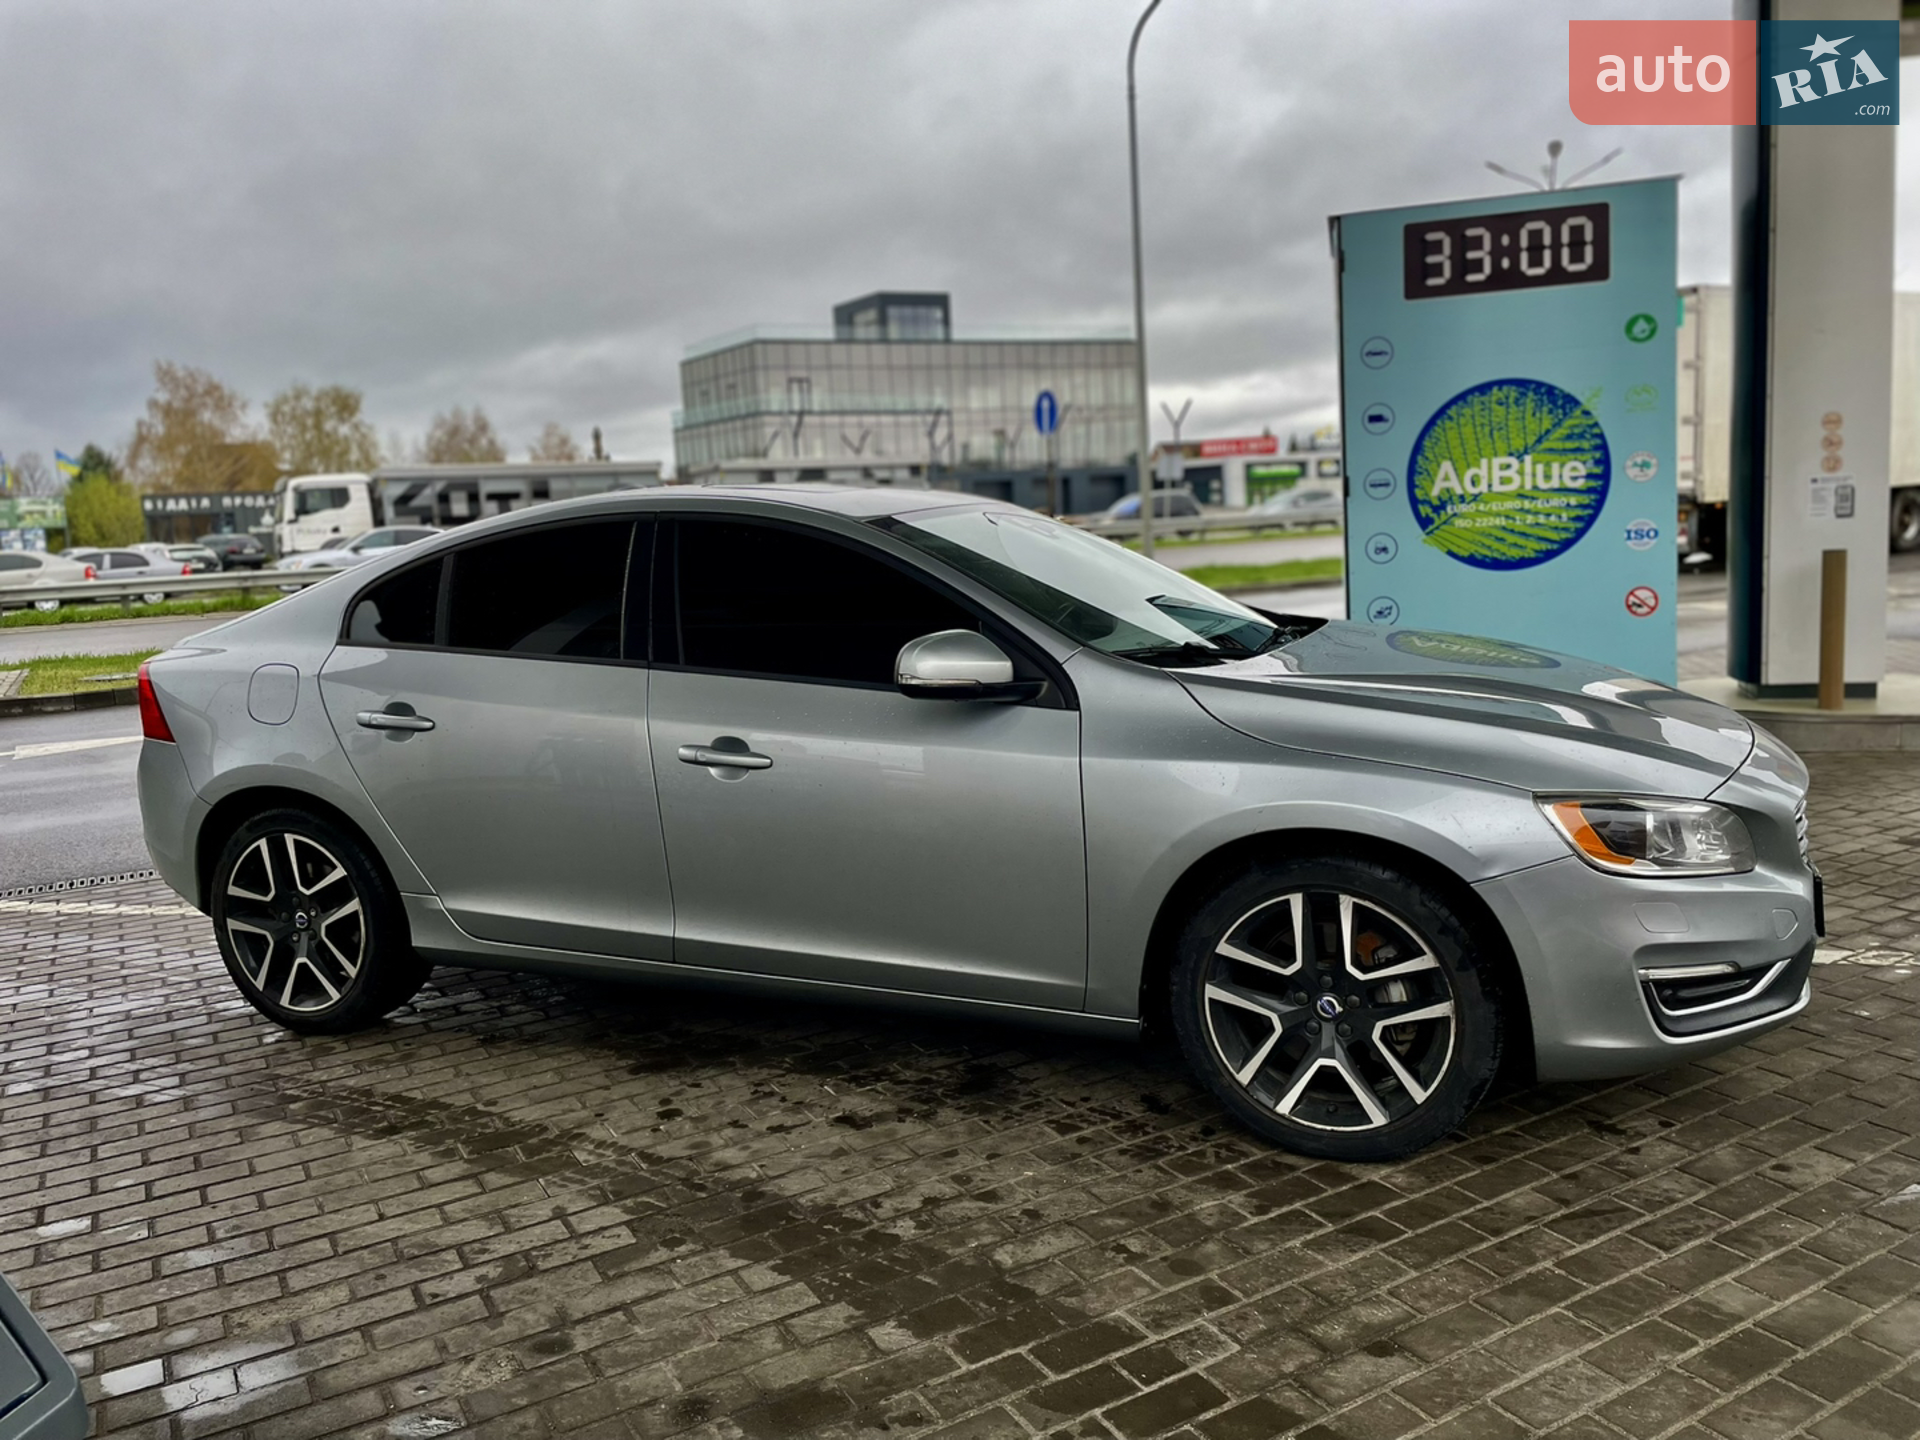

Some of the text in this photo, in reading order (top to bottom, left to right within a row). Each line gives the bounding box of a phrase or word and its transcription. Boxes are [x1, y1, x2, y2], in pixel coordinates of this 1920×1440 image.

[1424, 216, 1593, 286] 33:00
[1430, 454, 1588, 497] AdBlue
[1454, 518, 1473, 528] ISO
[1625, 528, 1659, 541] ISO
